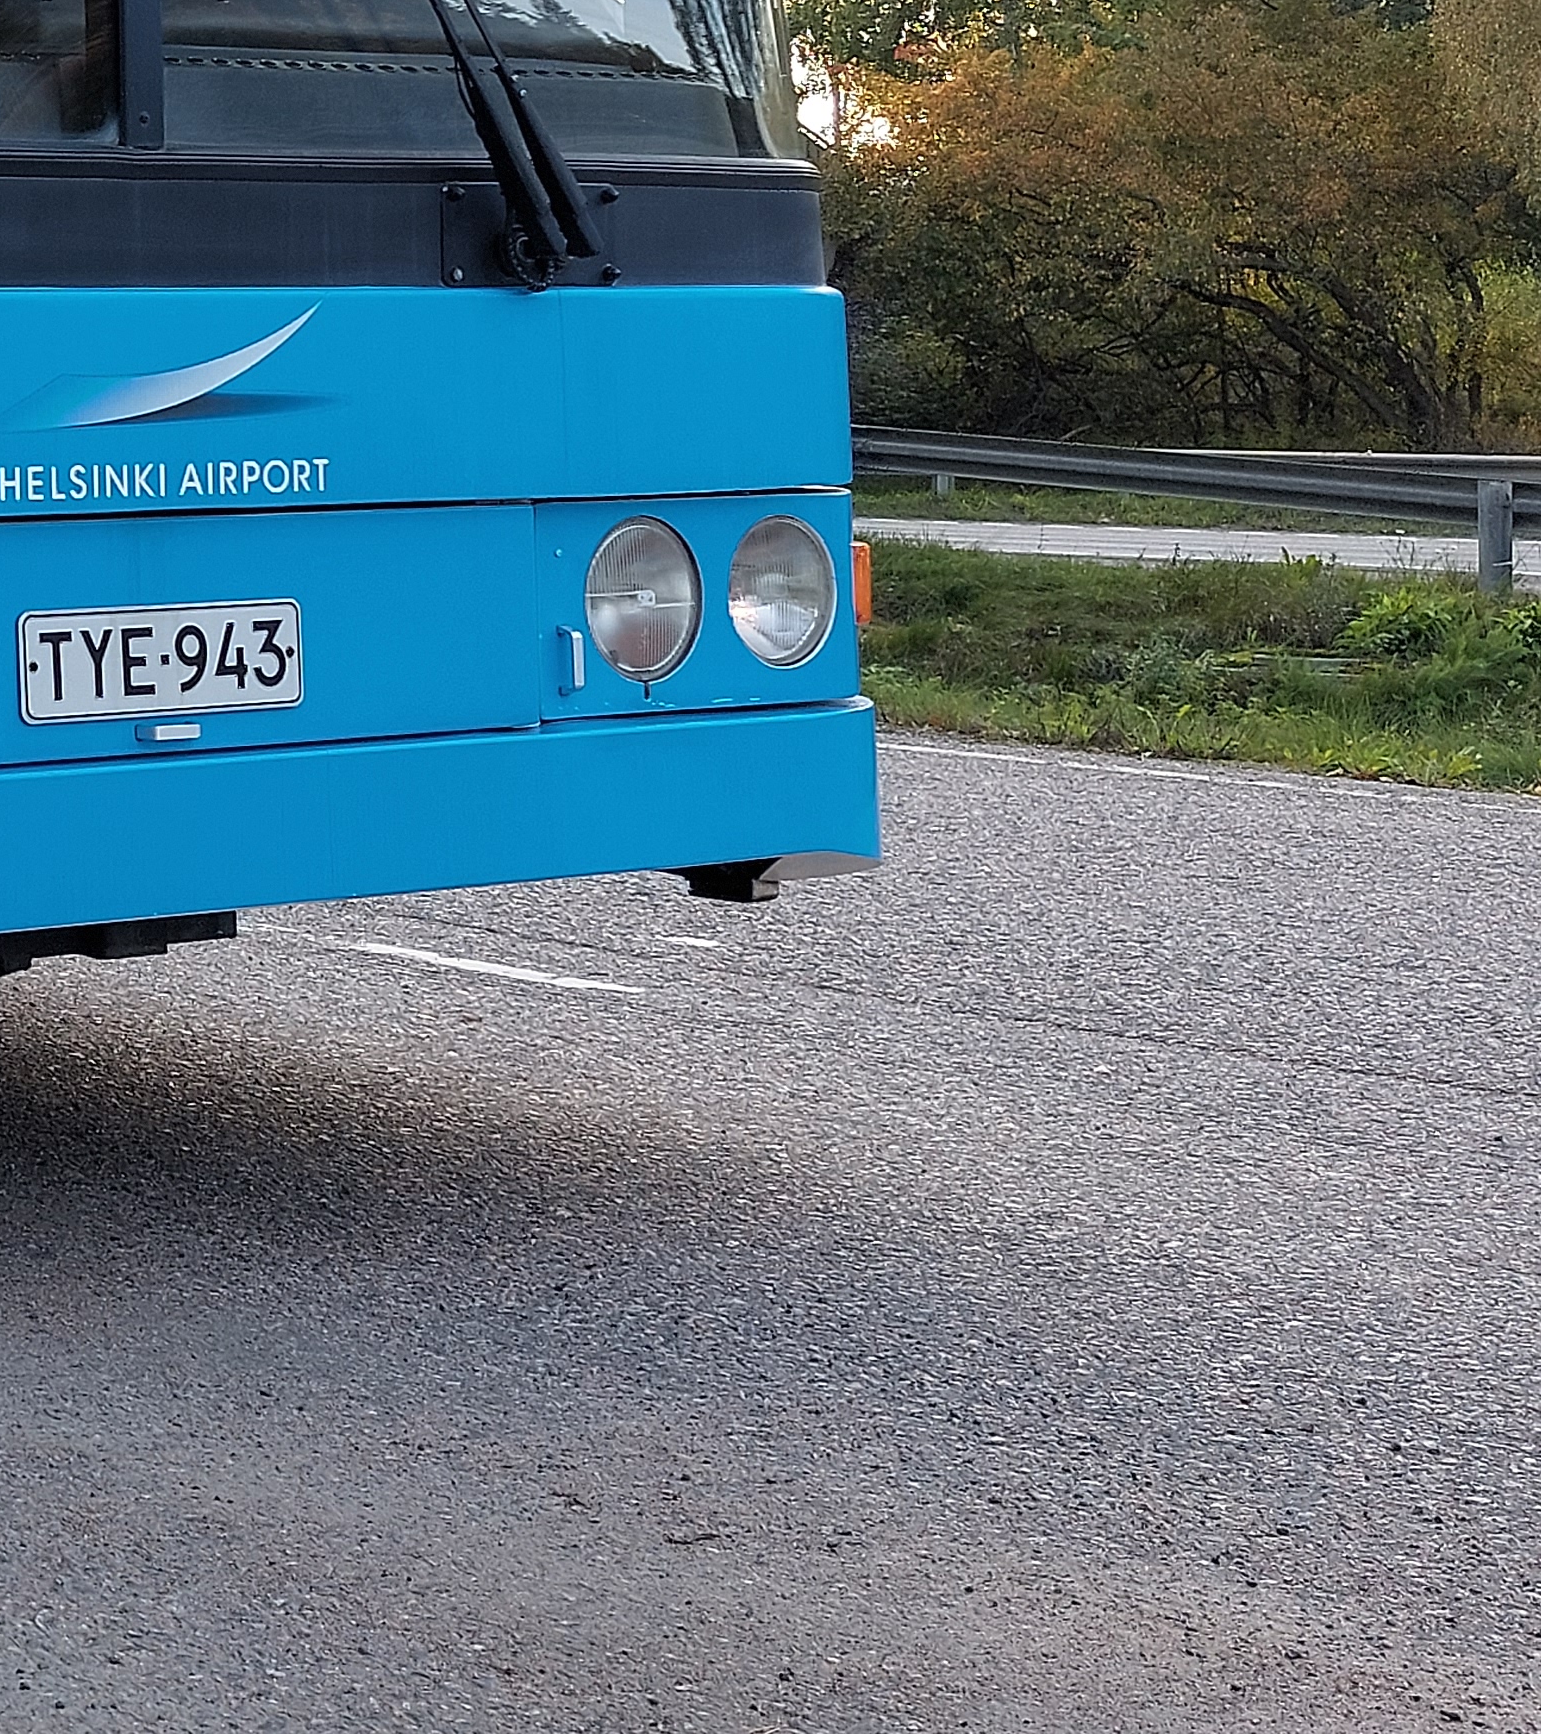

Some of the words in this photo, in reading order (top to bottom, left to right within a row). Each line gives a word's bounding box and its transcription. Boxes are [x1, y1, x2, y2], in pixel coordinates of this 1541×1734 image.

[0, 463, 166, 501] HELSINKI
[179, 458, 329, 496] AIRPORT
[38, 619, 287, 701] TYE-943
